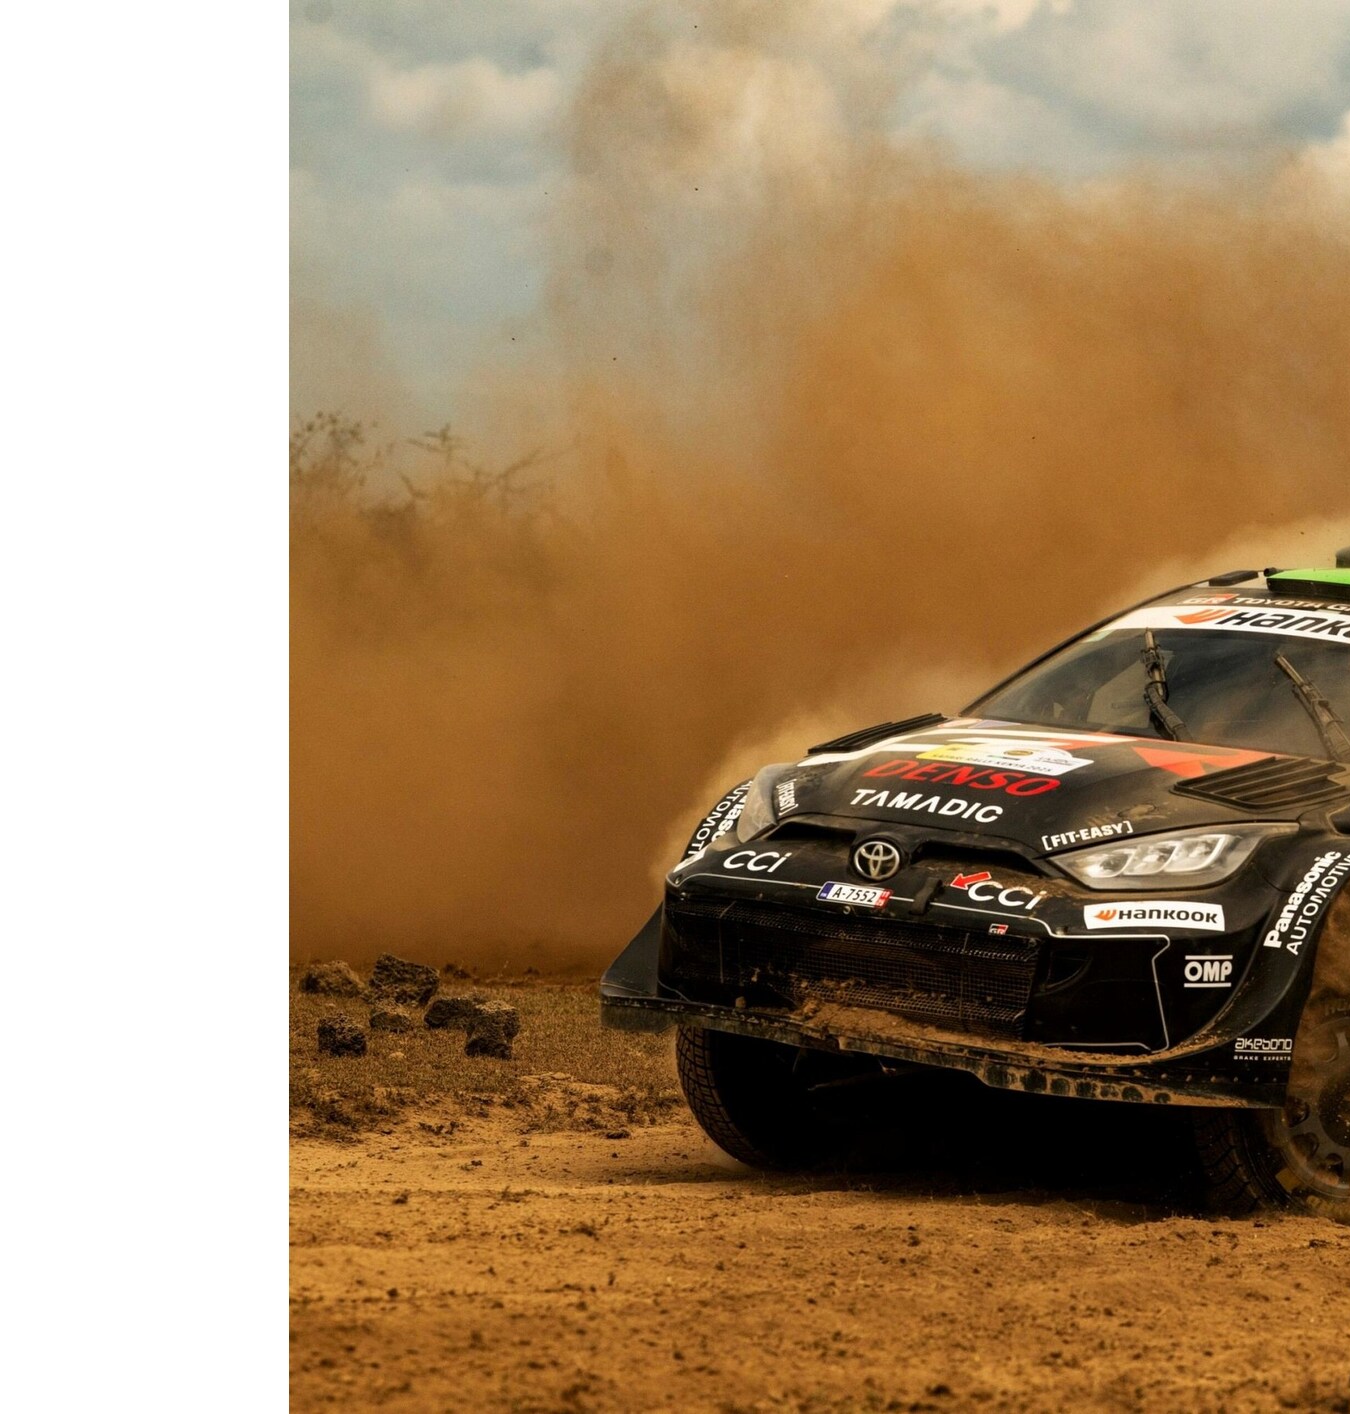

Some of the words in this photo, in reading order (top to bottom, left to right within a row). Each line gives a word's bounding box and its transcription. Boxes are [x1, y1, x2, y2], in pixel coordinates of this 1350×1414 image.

[1232, 597, 1324, 608] TOYOTA
[863, 759, 1061, 796] DENSO
[850, 788, 1003, 823] TAMADIC
[832, 886, 877, 903] A-7552
[1263, 851, 1342, 948] Panasonic
[1184, 961, 1232, 982] OMP
[1234, 1037, 1293, 1050] akebono
